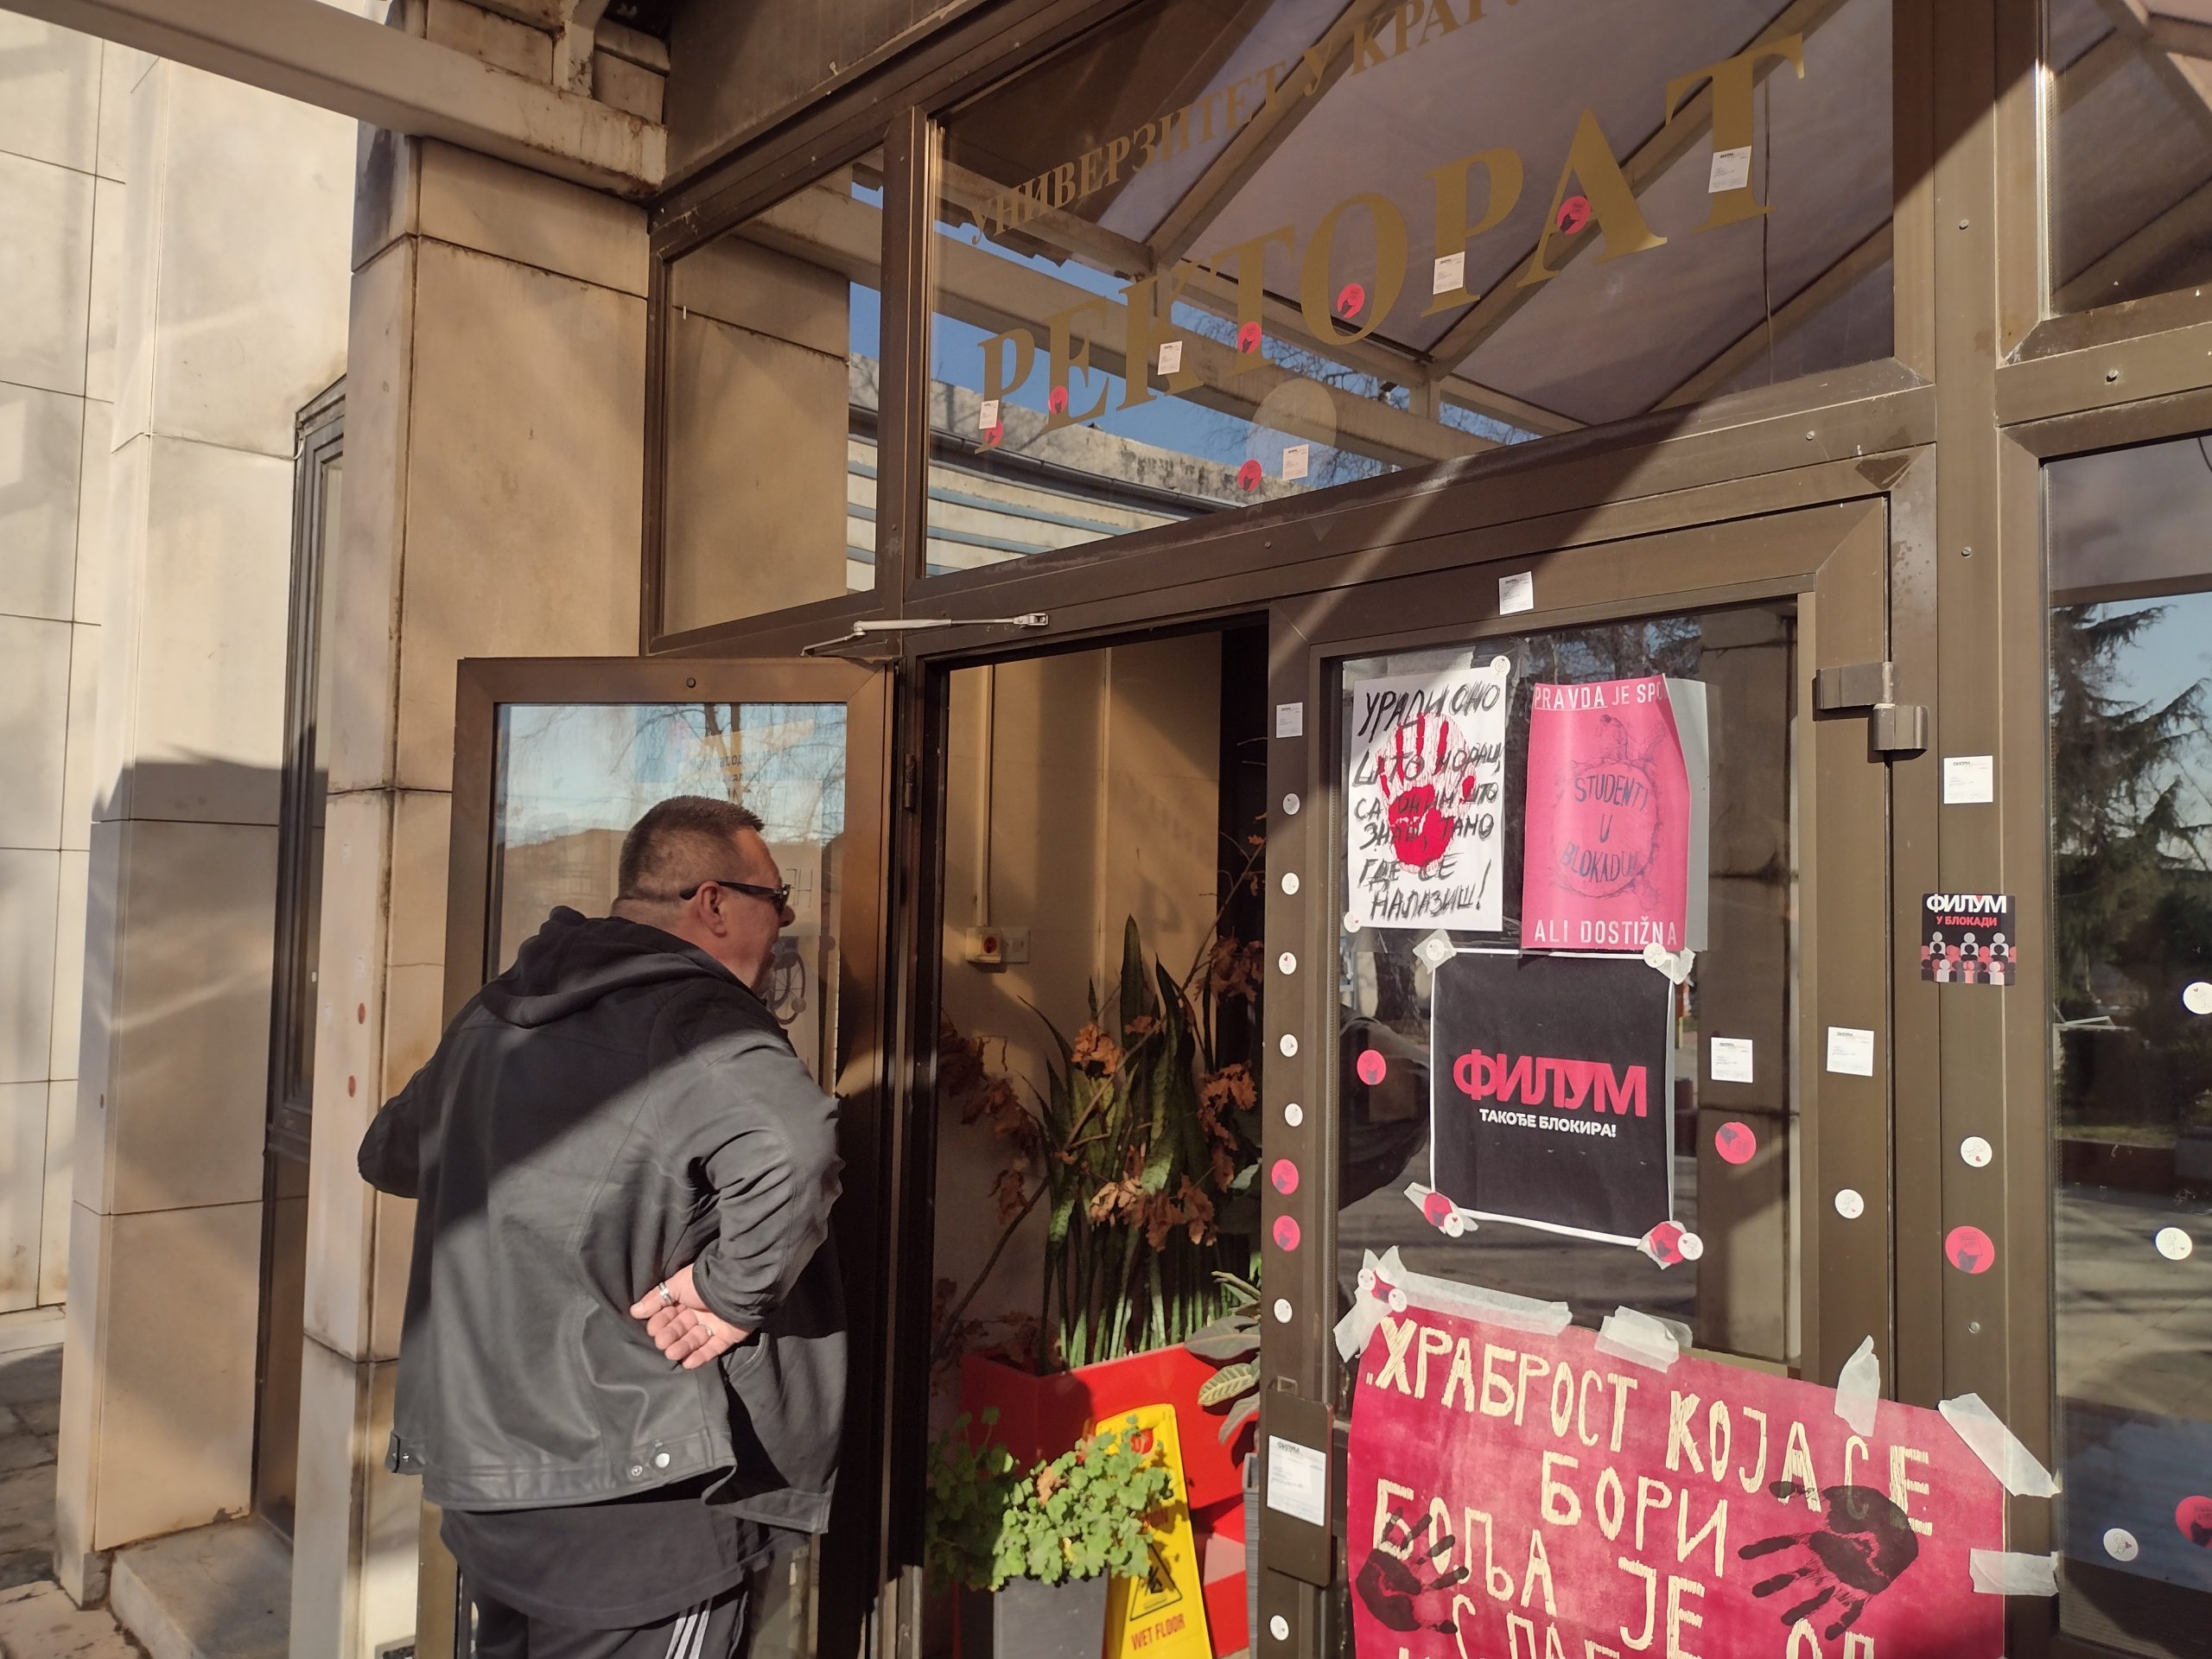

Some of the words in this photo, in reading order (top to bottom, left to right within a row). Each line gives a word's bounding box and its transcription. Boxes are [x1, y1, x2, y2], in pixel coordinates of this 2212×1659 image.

[969, 60, 1287, 245] УНИВЕРЗИТЕТ
[976, 32, 1804, 454] РЕКТОРАТ
[1357, 684, 1449, 743] УРАДИ
[1450, 680, 1500, 716] ОНО
[1535, 685, 1605, 709] PRAVDA
[1611, 685, 1630, 706] JE
[1354, 797, 1383, 822] СА
[1573, 773, 1649, 811] STUDENTI
[1440, 813, 1494, 842] ТАМО
[1599, 814, 1613, 843] U
[1927, 893, 2006, 913] ФИЛУМ
[1936, 916, 1943, 925] У
[1945, 917, 1997, 927] БЛОКАДИ
[1535, 919, 1569, 944] ALI
[1580, 916, 1678, 945] DOSTIŽNA
[1452, 1049, 1648, 1118] ФИЛУМ
[1538, 1116, 1618, 1138] БЛОКИРА!
[1665, 1390, 1822, 1513] КОЈА
[1844, 1434, 1934, 1536] СЕ
[1540, 1450, 1728, 1578] БОРИ
[1372, 1478, 1557, 1617] БОЉА
[1618, 1556, 1706, 1659] ЈЕ
[1130, 1626, 1153, 1650] WET
[1155, 1612, 1185, 1640] FLOOR
